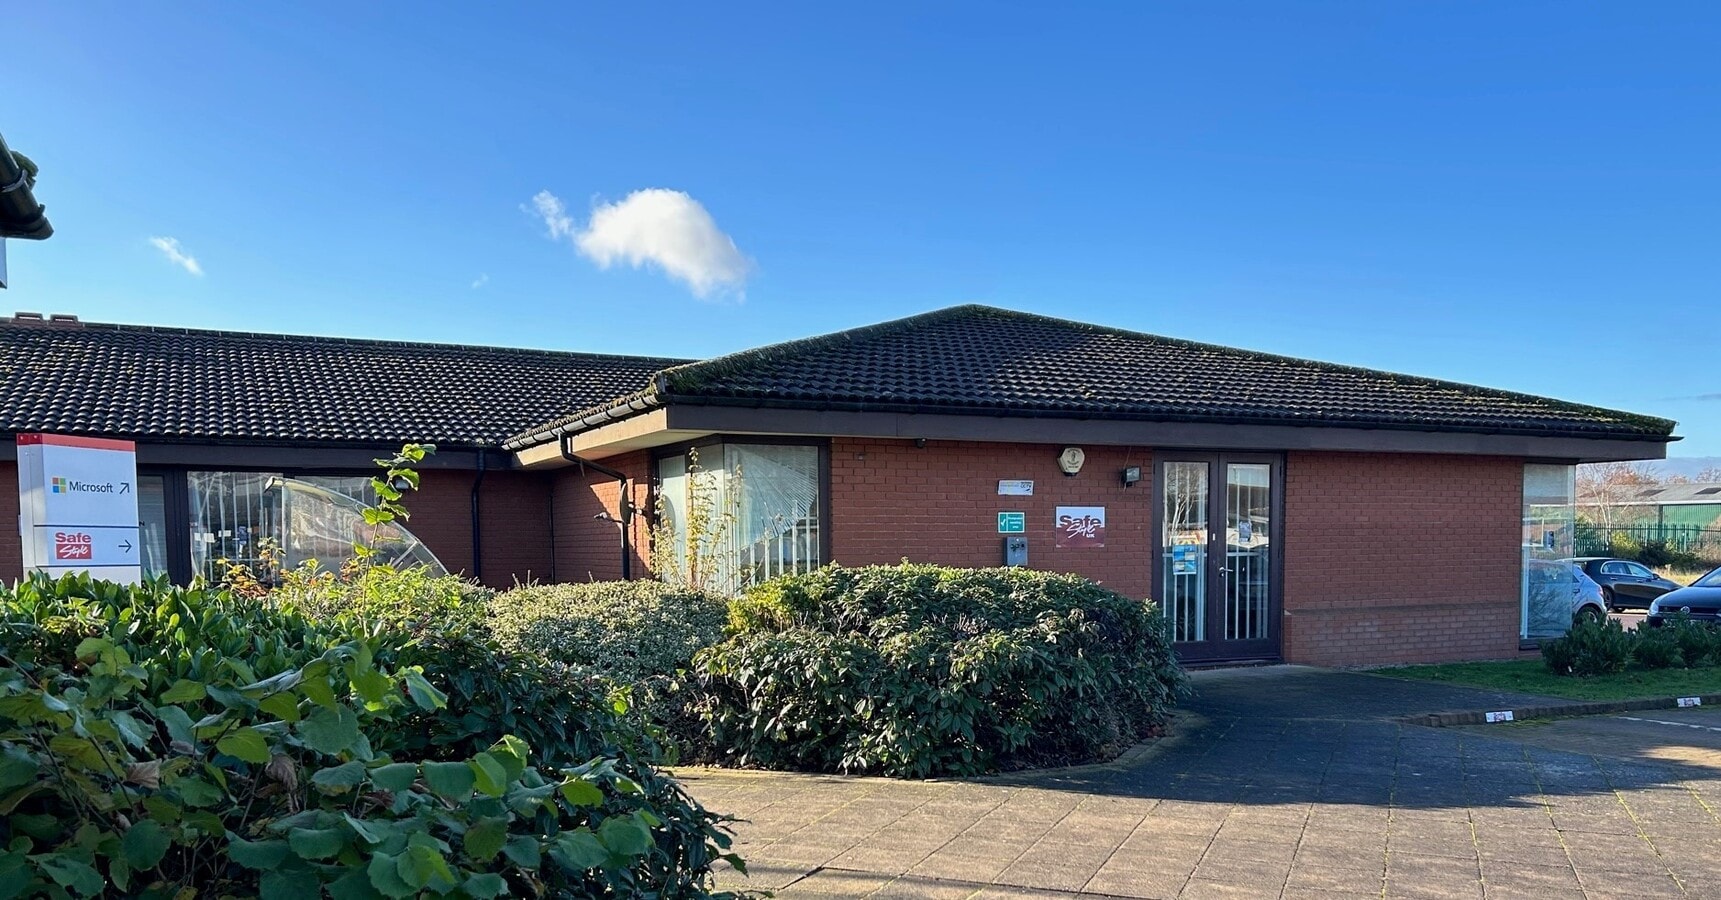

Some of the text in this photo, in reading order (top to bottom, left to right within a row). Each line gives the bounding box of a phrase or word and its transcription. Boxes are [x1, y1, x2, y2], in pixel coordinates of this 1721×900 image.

[69, 481, 113, 493] Microsoft
[1059, 515, 1101, 526] Safe
[55, 532, 91, 543] Safe
[59, 544, 89, 558] Style
